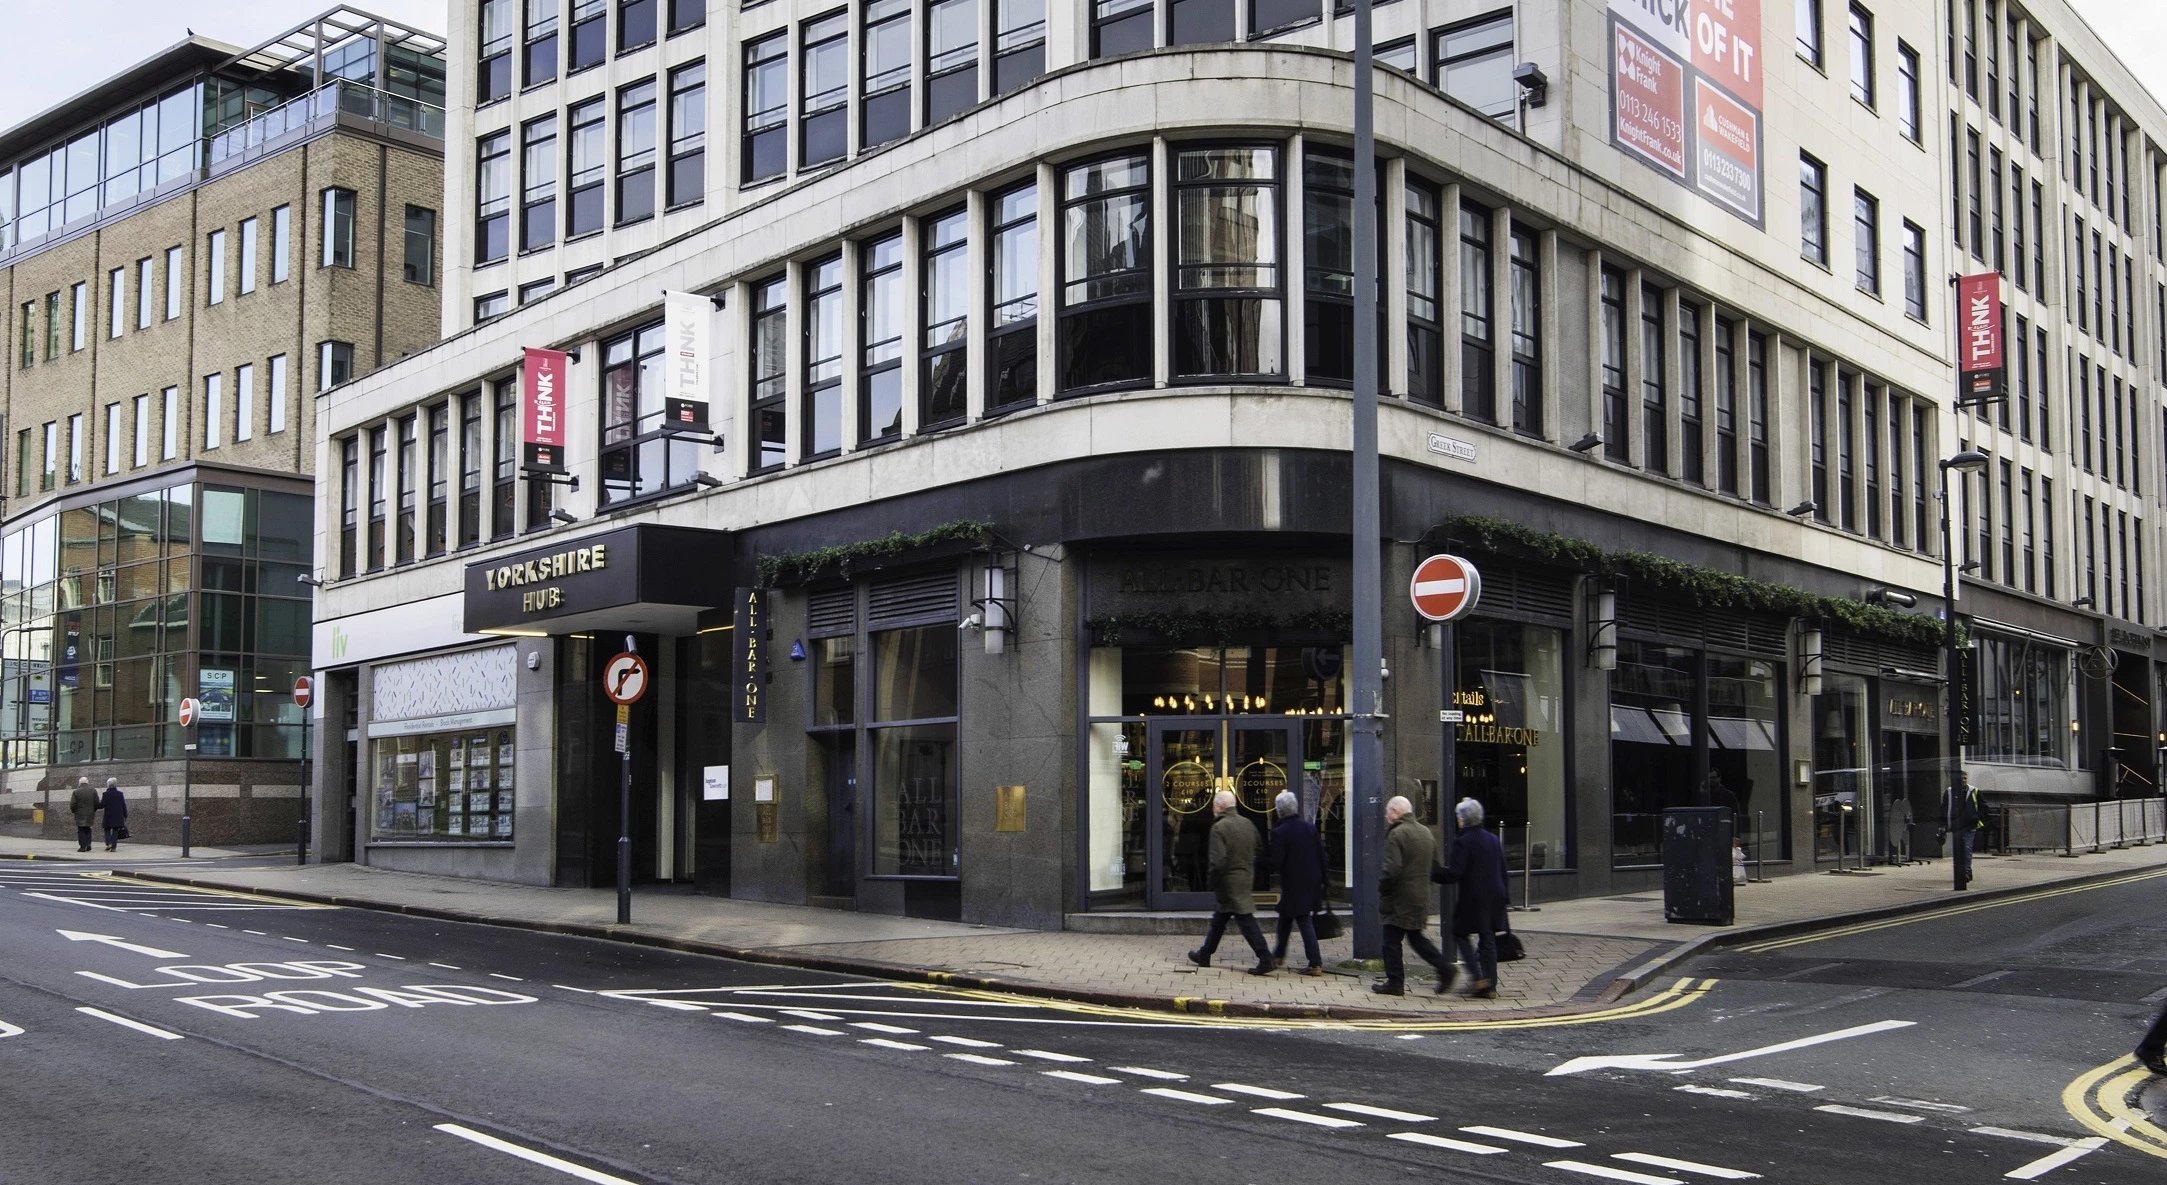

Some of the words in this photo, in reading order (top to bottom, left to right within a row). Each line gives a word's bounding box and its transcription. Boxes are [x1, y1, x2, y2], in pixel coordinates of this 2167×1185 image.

[1635, 44, 1661, 77] Knight
[1697, 12, 1727, 63] OF
[1733, 34, 1754, 83] IT
[1636, 66, 1658, 95] Frank
[1619, 89, 1640, 118] 0113
[1642, 103, 1660, 130] 246
[1661, 115, 1681, 143] 1533
[1718, 115, 1746, 139] CUSHMAN
[1619, 116, 1682, 165] KnightFrank.co.uk
[1718, 124, 1751, 153] WAKEFIELD
[1703, 148, 1721, 174] 0113
[1721, 158, 1734, 182] 233
[1734, 166, 1751, 192] 7300
[1430, 435, 1452, 452] GREEK
[1452, 441, 1475, 458] STREET
[485, 543, 606, 592] YORKSHIRE
[523, 586, 562, 613] HUB
[332, 625, 348, 660] liv
[893, 777, 942, 804] ALL
[894, 808, 942, 835] BAR
[894, 838, 942, 865] ONE
[75, 960, 367, 989] LOOP
[173, 984, 540, 1019] ROAD
